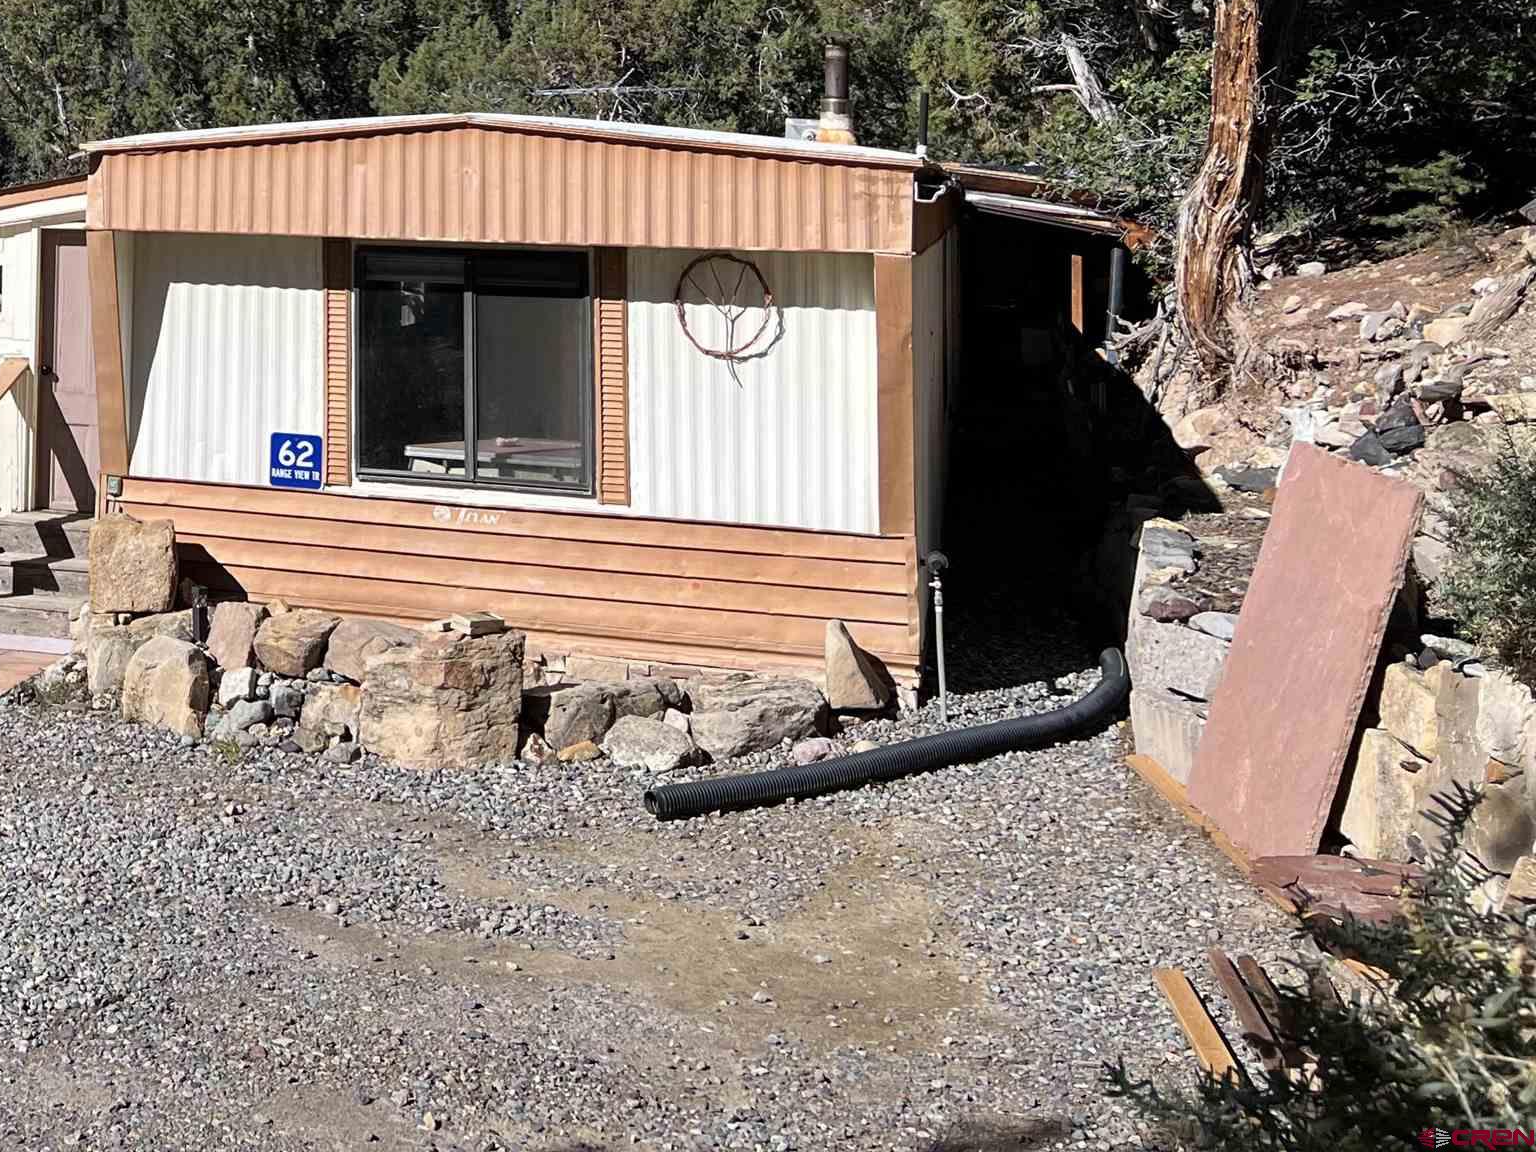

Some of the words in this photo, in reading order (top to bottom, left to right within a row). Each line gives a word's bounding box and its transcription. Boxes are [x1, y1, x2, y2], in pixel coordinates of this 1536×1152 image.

[278, 440, 314, 467] 62
[271, 468, 293, 479] RANGE
[294, 469, 310, 480] VIEW
[311, 471, 321, 481] TR
